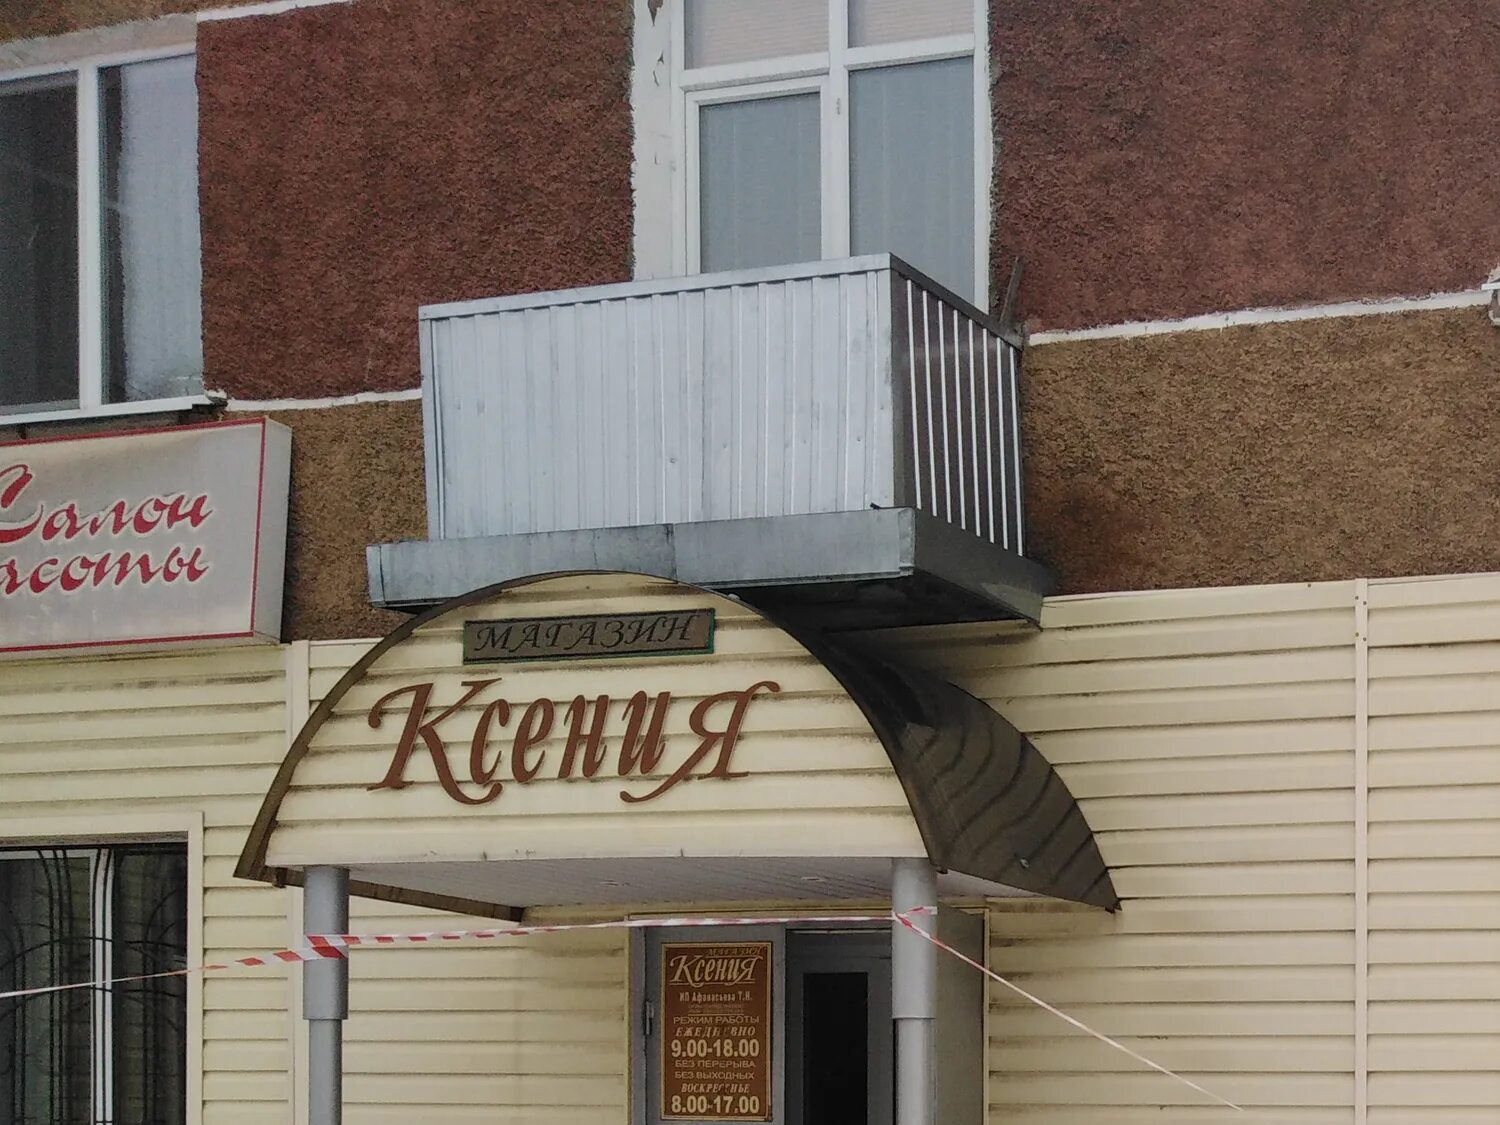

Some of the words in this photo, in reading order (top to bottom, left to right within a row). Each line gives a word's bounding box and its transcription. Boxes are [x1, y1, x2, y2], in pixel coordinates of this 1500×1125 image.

[474, 614, 694, 652] МАГАЗИН
[366, 677, 781, 805] Ксения
[669, 955, 764, 988] Ксения
[673, 1016, 713, 1024] РЕЖИМ
[715, 1015, 760, 1024] РАБОТЫ
[671, 1039, 760, 1057] 9.00-18.00
[675, 1060, 695, 1068] БЕЗ
[697, 1060, 757, 1068] ПЕРЕРЫВА
[675, 1071, 694, 1079] БЕЗ
[696, 1071, 755, 1080] ВЫХОДНЫХ
[671, 1095, 760, 1113] 8.00-17.00
